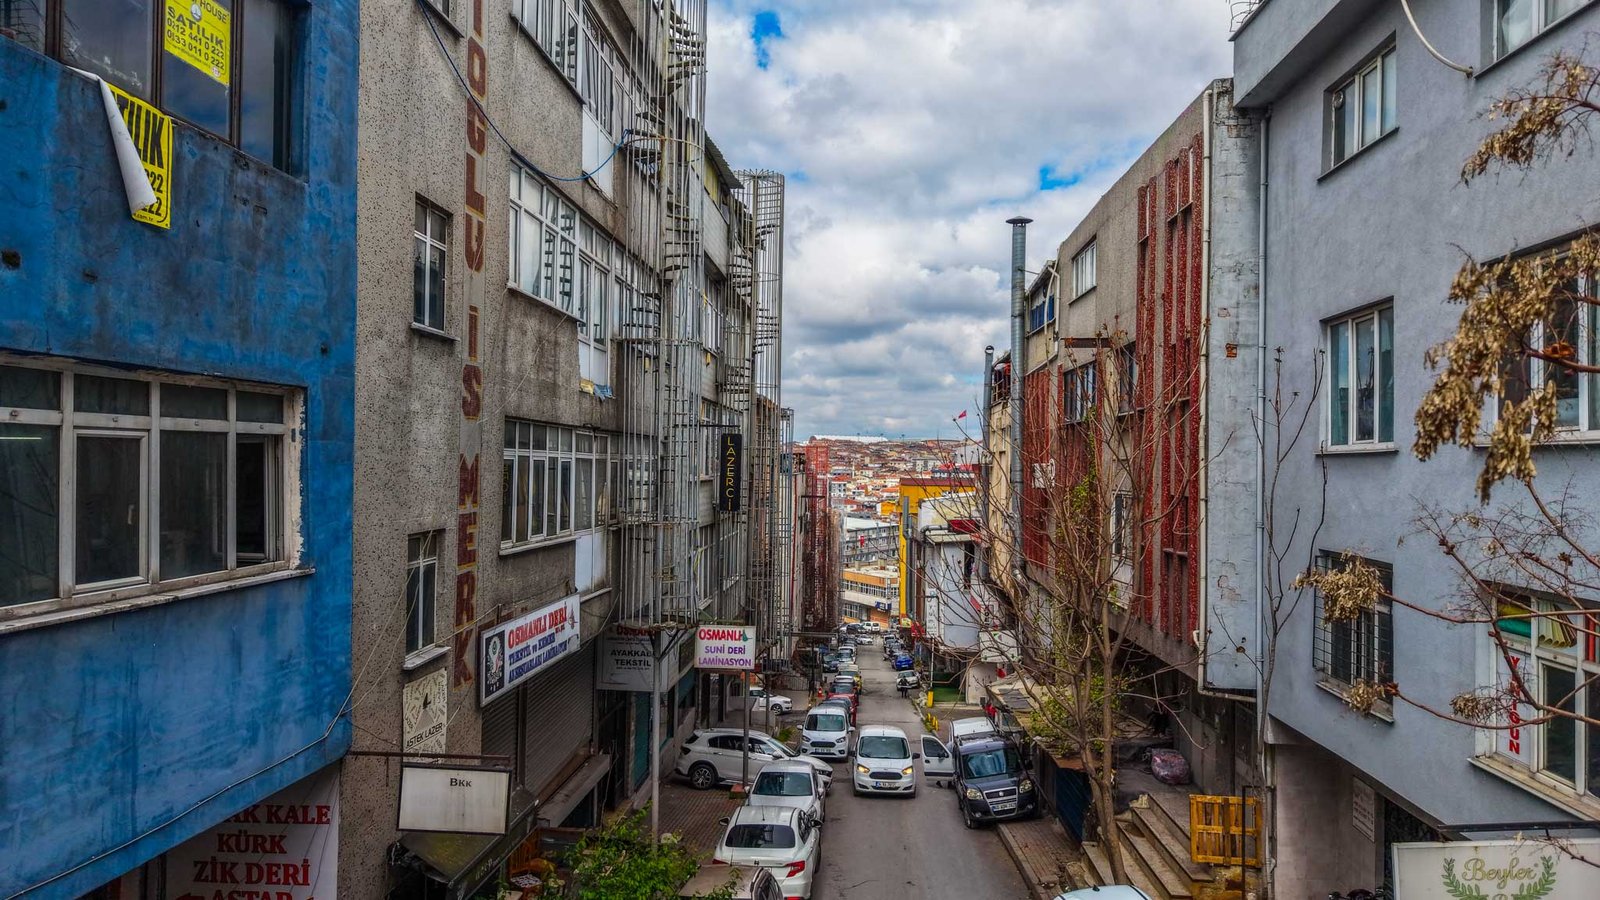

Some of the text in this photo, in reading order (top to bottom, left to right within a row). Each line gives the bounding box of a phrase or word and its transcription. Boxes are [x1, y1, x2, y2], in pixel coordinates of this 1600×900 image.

[200, 0, 227, 24] HOUSE
[167, 6, 224, 50] SATILIK
[210, 57, 225, 70] 222
[508, 614, 547, 649] OSMANLI
[699, 629, 742, 641] OSMANLI
[698, 656, 752, 666] LAMİNASYON
[705, 644, 746, 655] SUNİ DERİ
[265, 804, 331, 825] KALE
[217, 829, 288, 854] KÜRK
[193, 856, 311, 886] ZİK DERİ
[1461, 857, 1537, 889] Beyler
